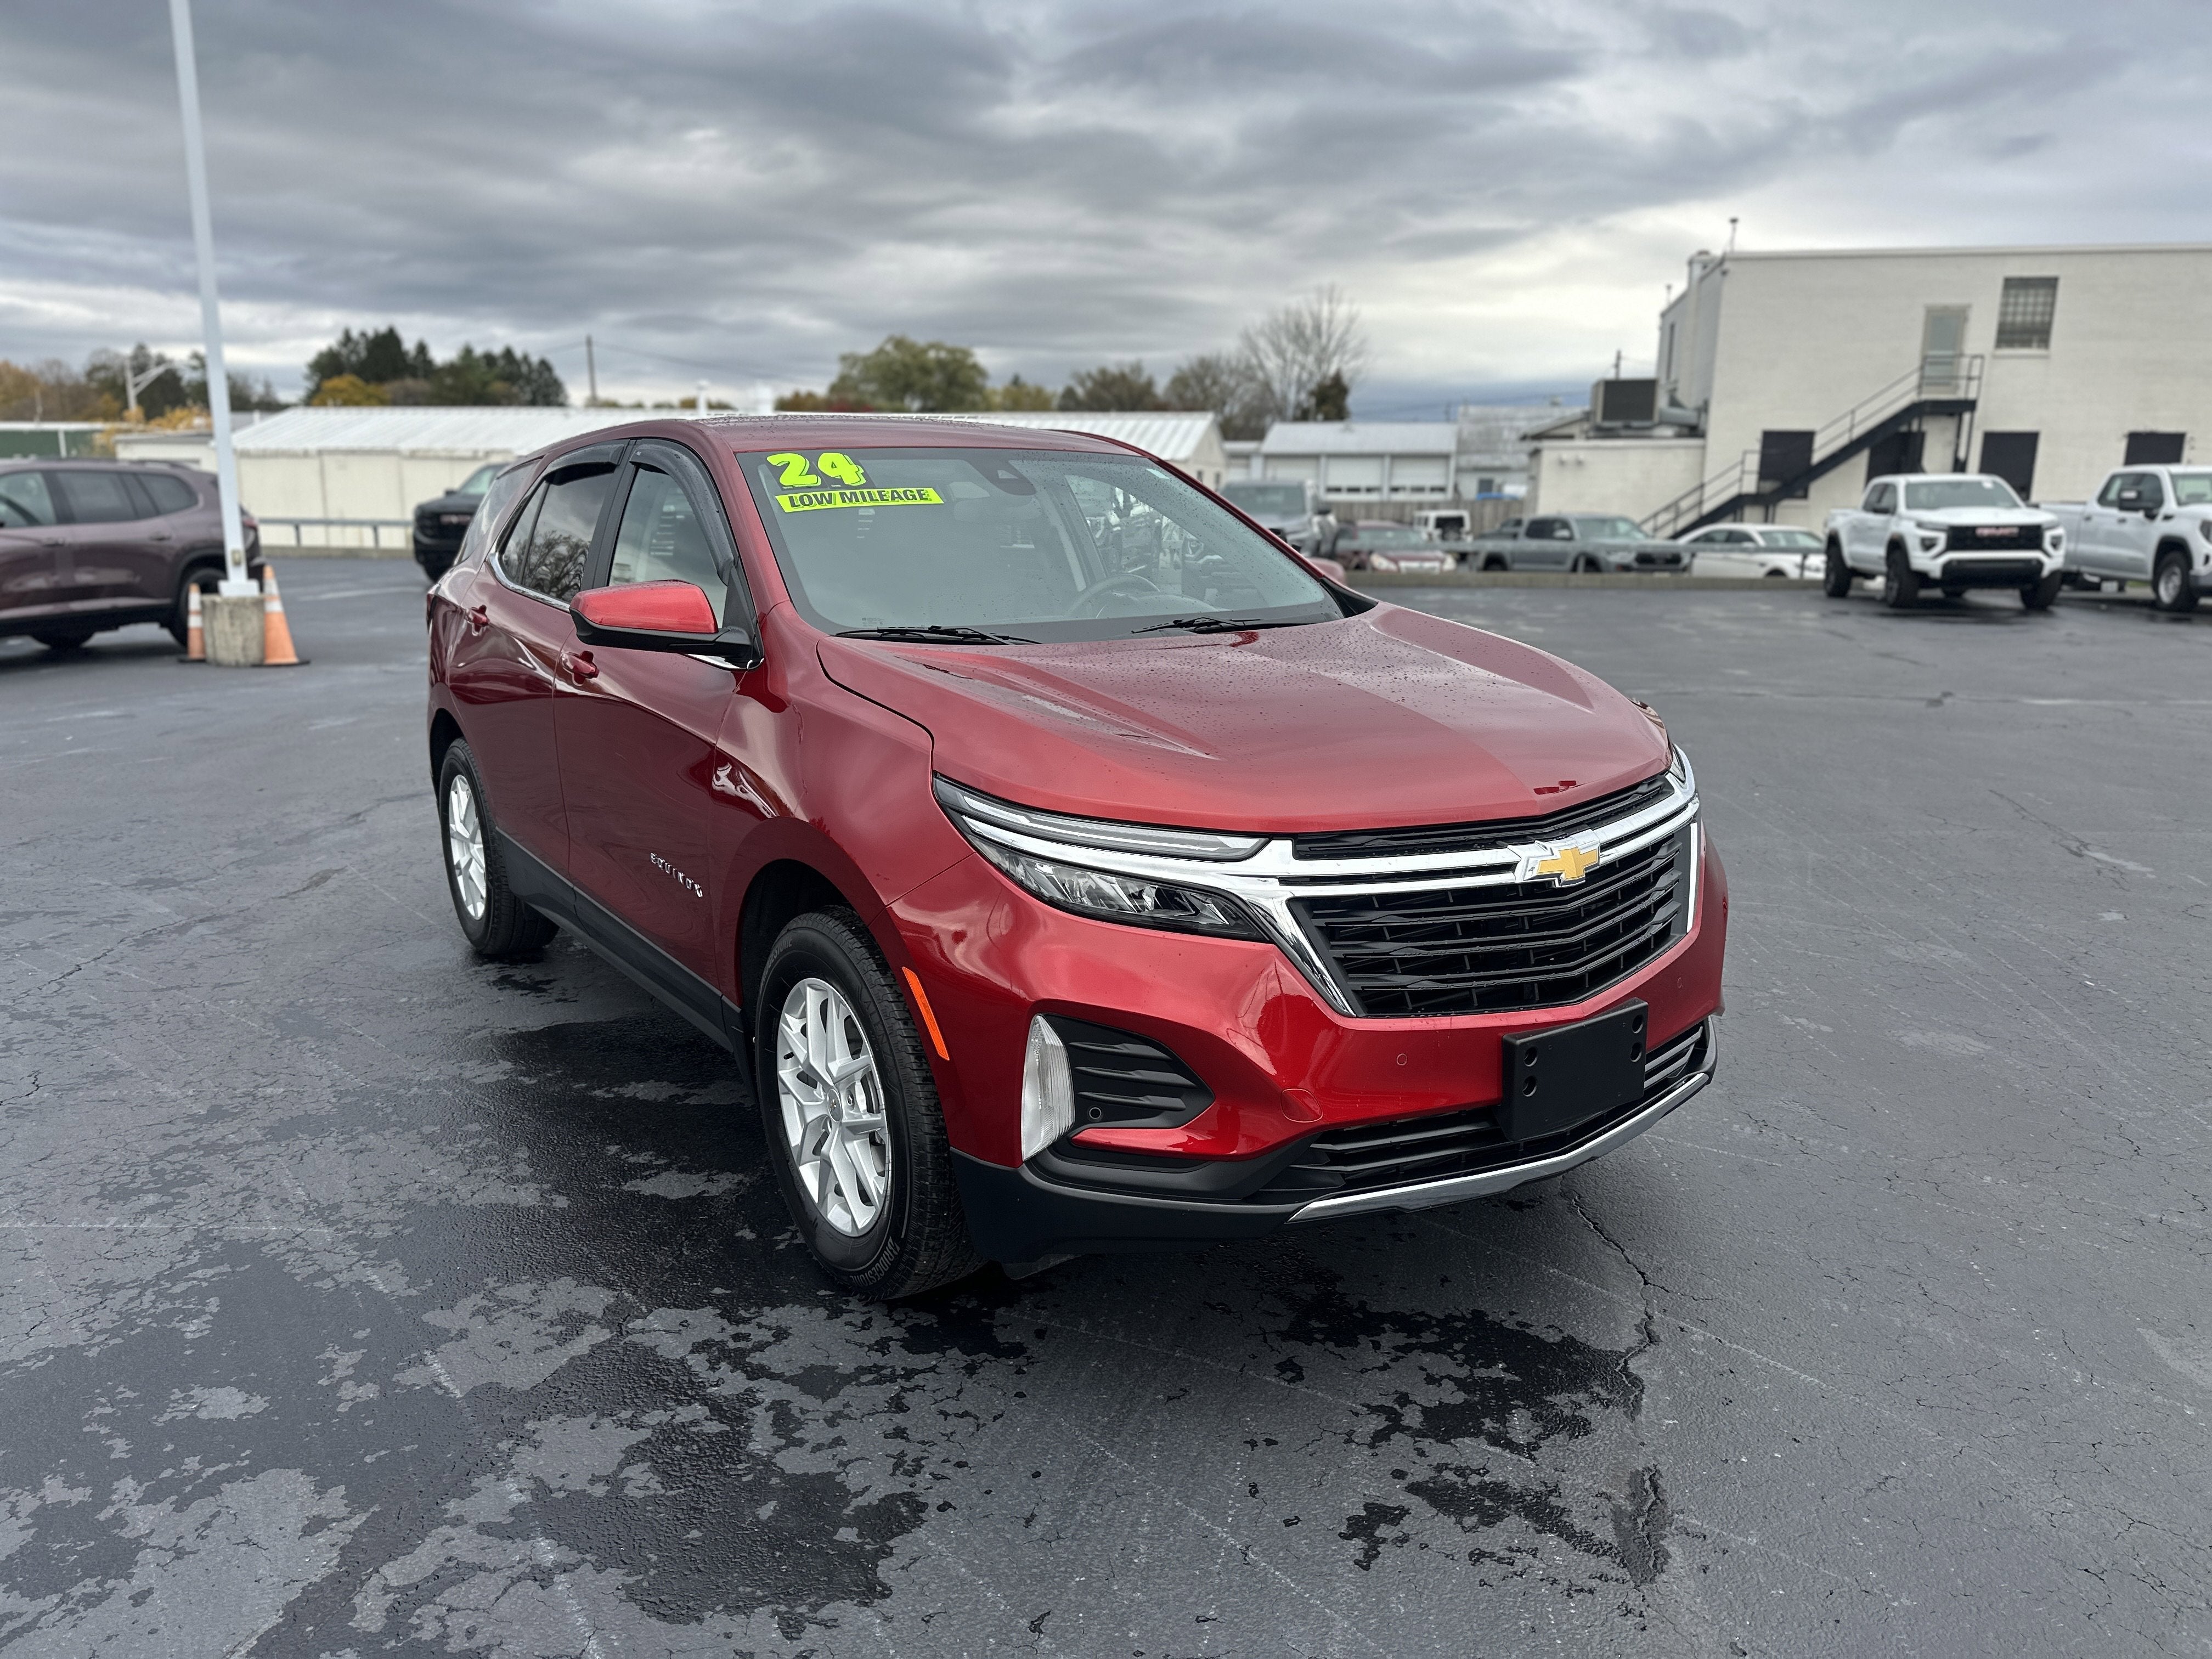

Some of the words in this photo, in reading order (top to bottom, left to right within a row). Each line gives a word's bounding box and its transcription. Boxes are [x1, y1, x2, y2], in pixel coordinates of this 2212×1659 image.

[766, 453, 866, 487] 24
[788, 492, 836, 508] LOW
[839, 489, 932, 503] MILEAGE
[849, 1236, 900, 1287] BRIDGESTONE
